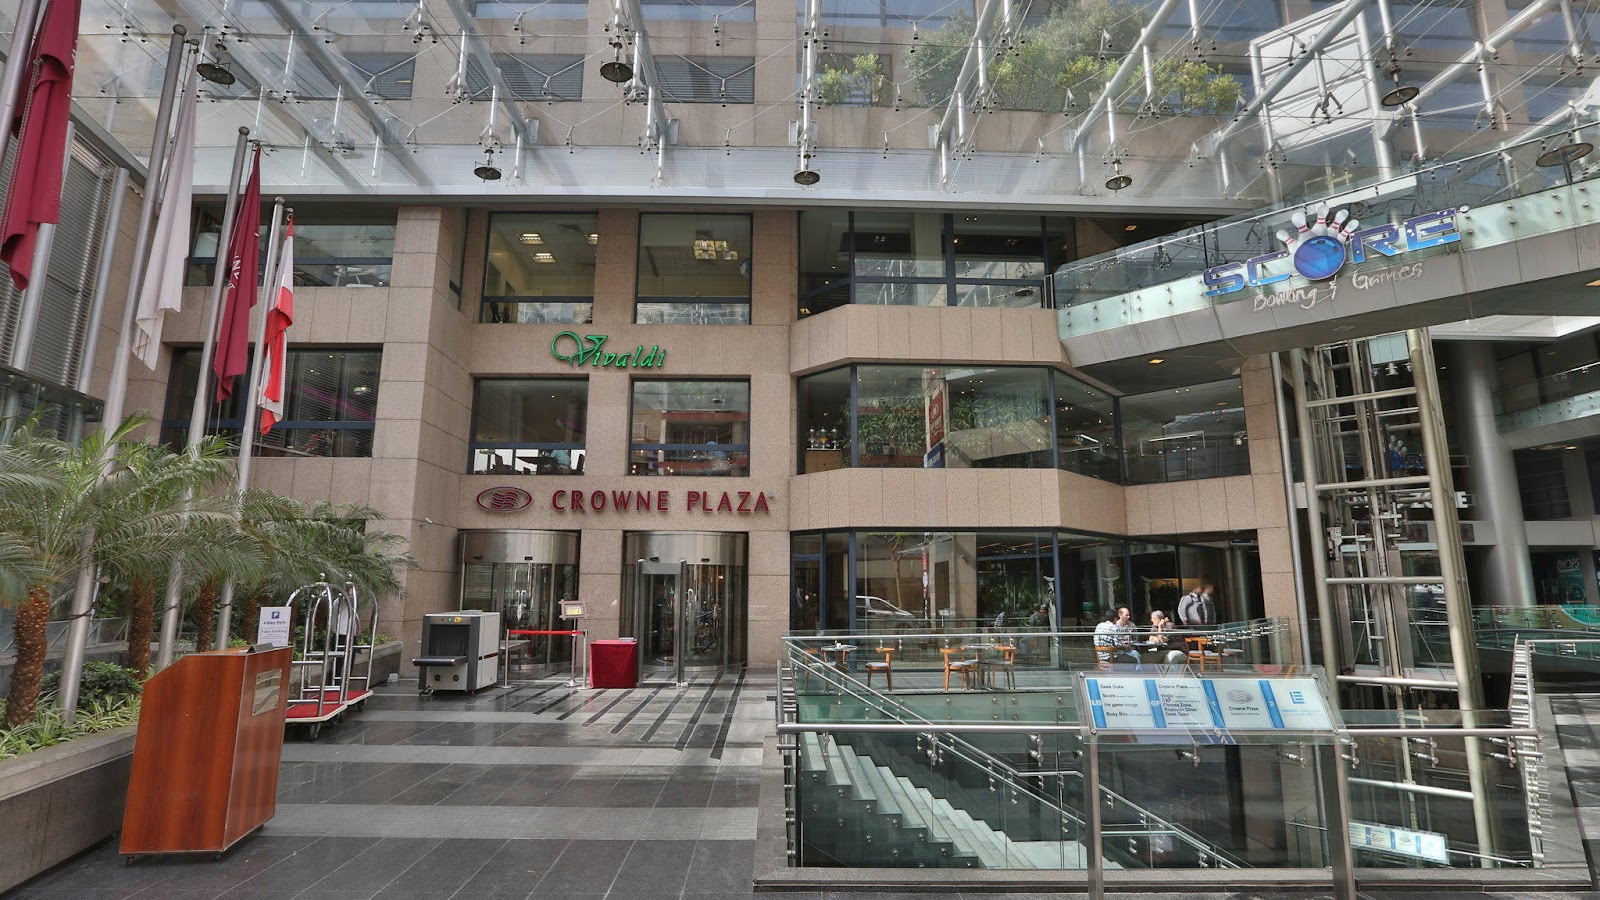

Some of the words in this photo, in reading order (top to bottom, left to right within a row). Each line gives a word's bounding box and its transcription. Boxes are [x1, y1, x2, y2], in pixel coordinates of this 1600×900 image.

[1203, 204, 1462, 297] SCORE
[1254, 284, 1318, 311] Bowling
[1352, 262, 1424, 290] Games
[551, 330, 667, 368] Vivaldi
[552, 489, 670, 512] CROWNE
[687, 490, 770, 513] PLAZA
